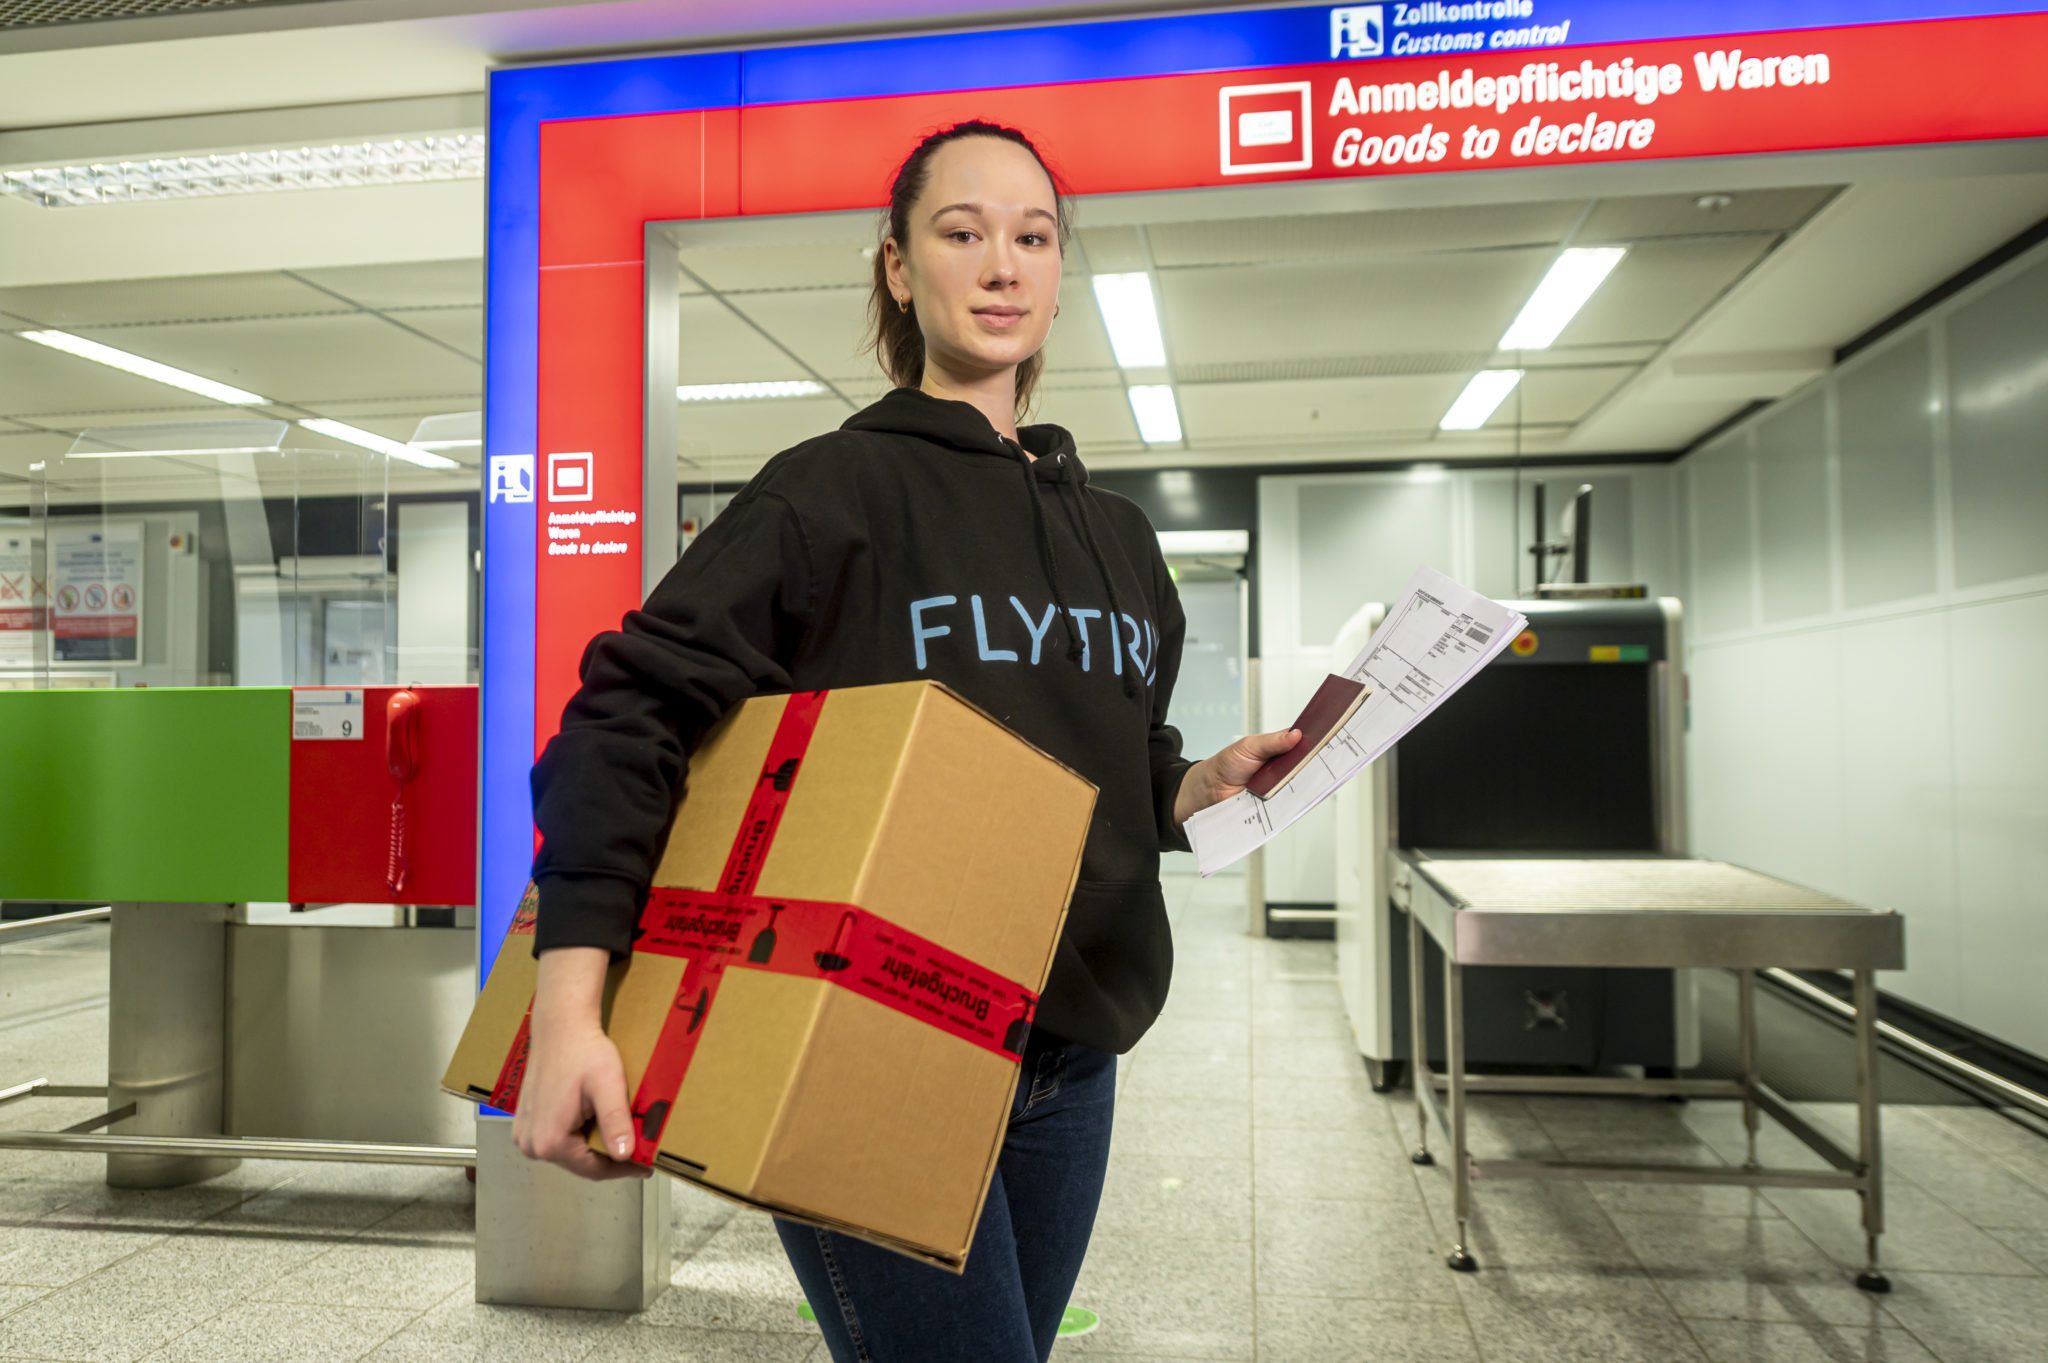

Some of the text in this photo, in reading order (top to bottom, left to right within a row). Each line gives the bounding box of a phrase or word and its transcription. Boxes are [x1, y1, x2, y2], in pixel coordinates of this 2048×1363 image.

[1391, 18, 1572, 56] Customs control
[1392, 0, 1534, 27] Zollkontrolle
[1327, 48, 1831, 117] Anmeldepflichtige Waren
[1331, 122, 1451, 169] Goods
[1459, 124, 1501, 160] to
[1510, 111, 1656, 158] declare
[342, 719, 352, 736] 9
[880, 955, 990, 1021] Bruchgefahr
